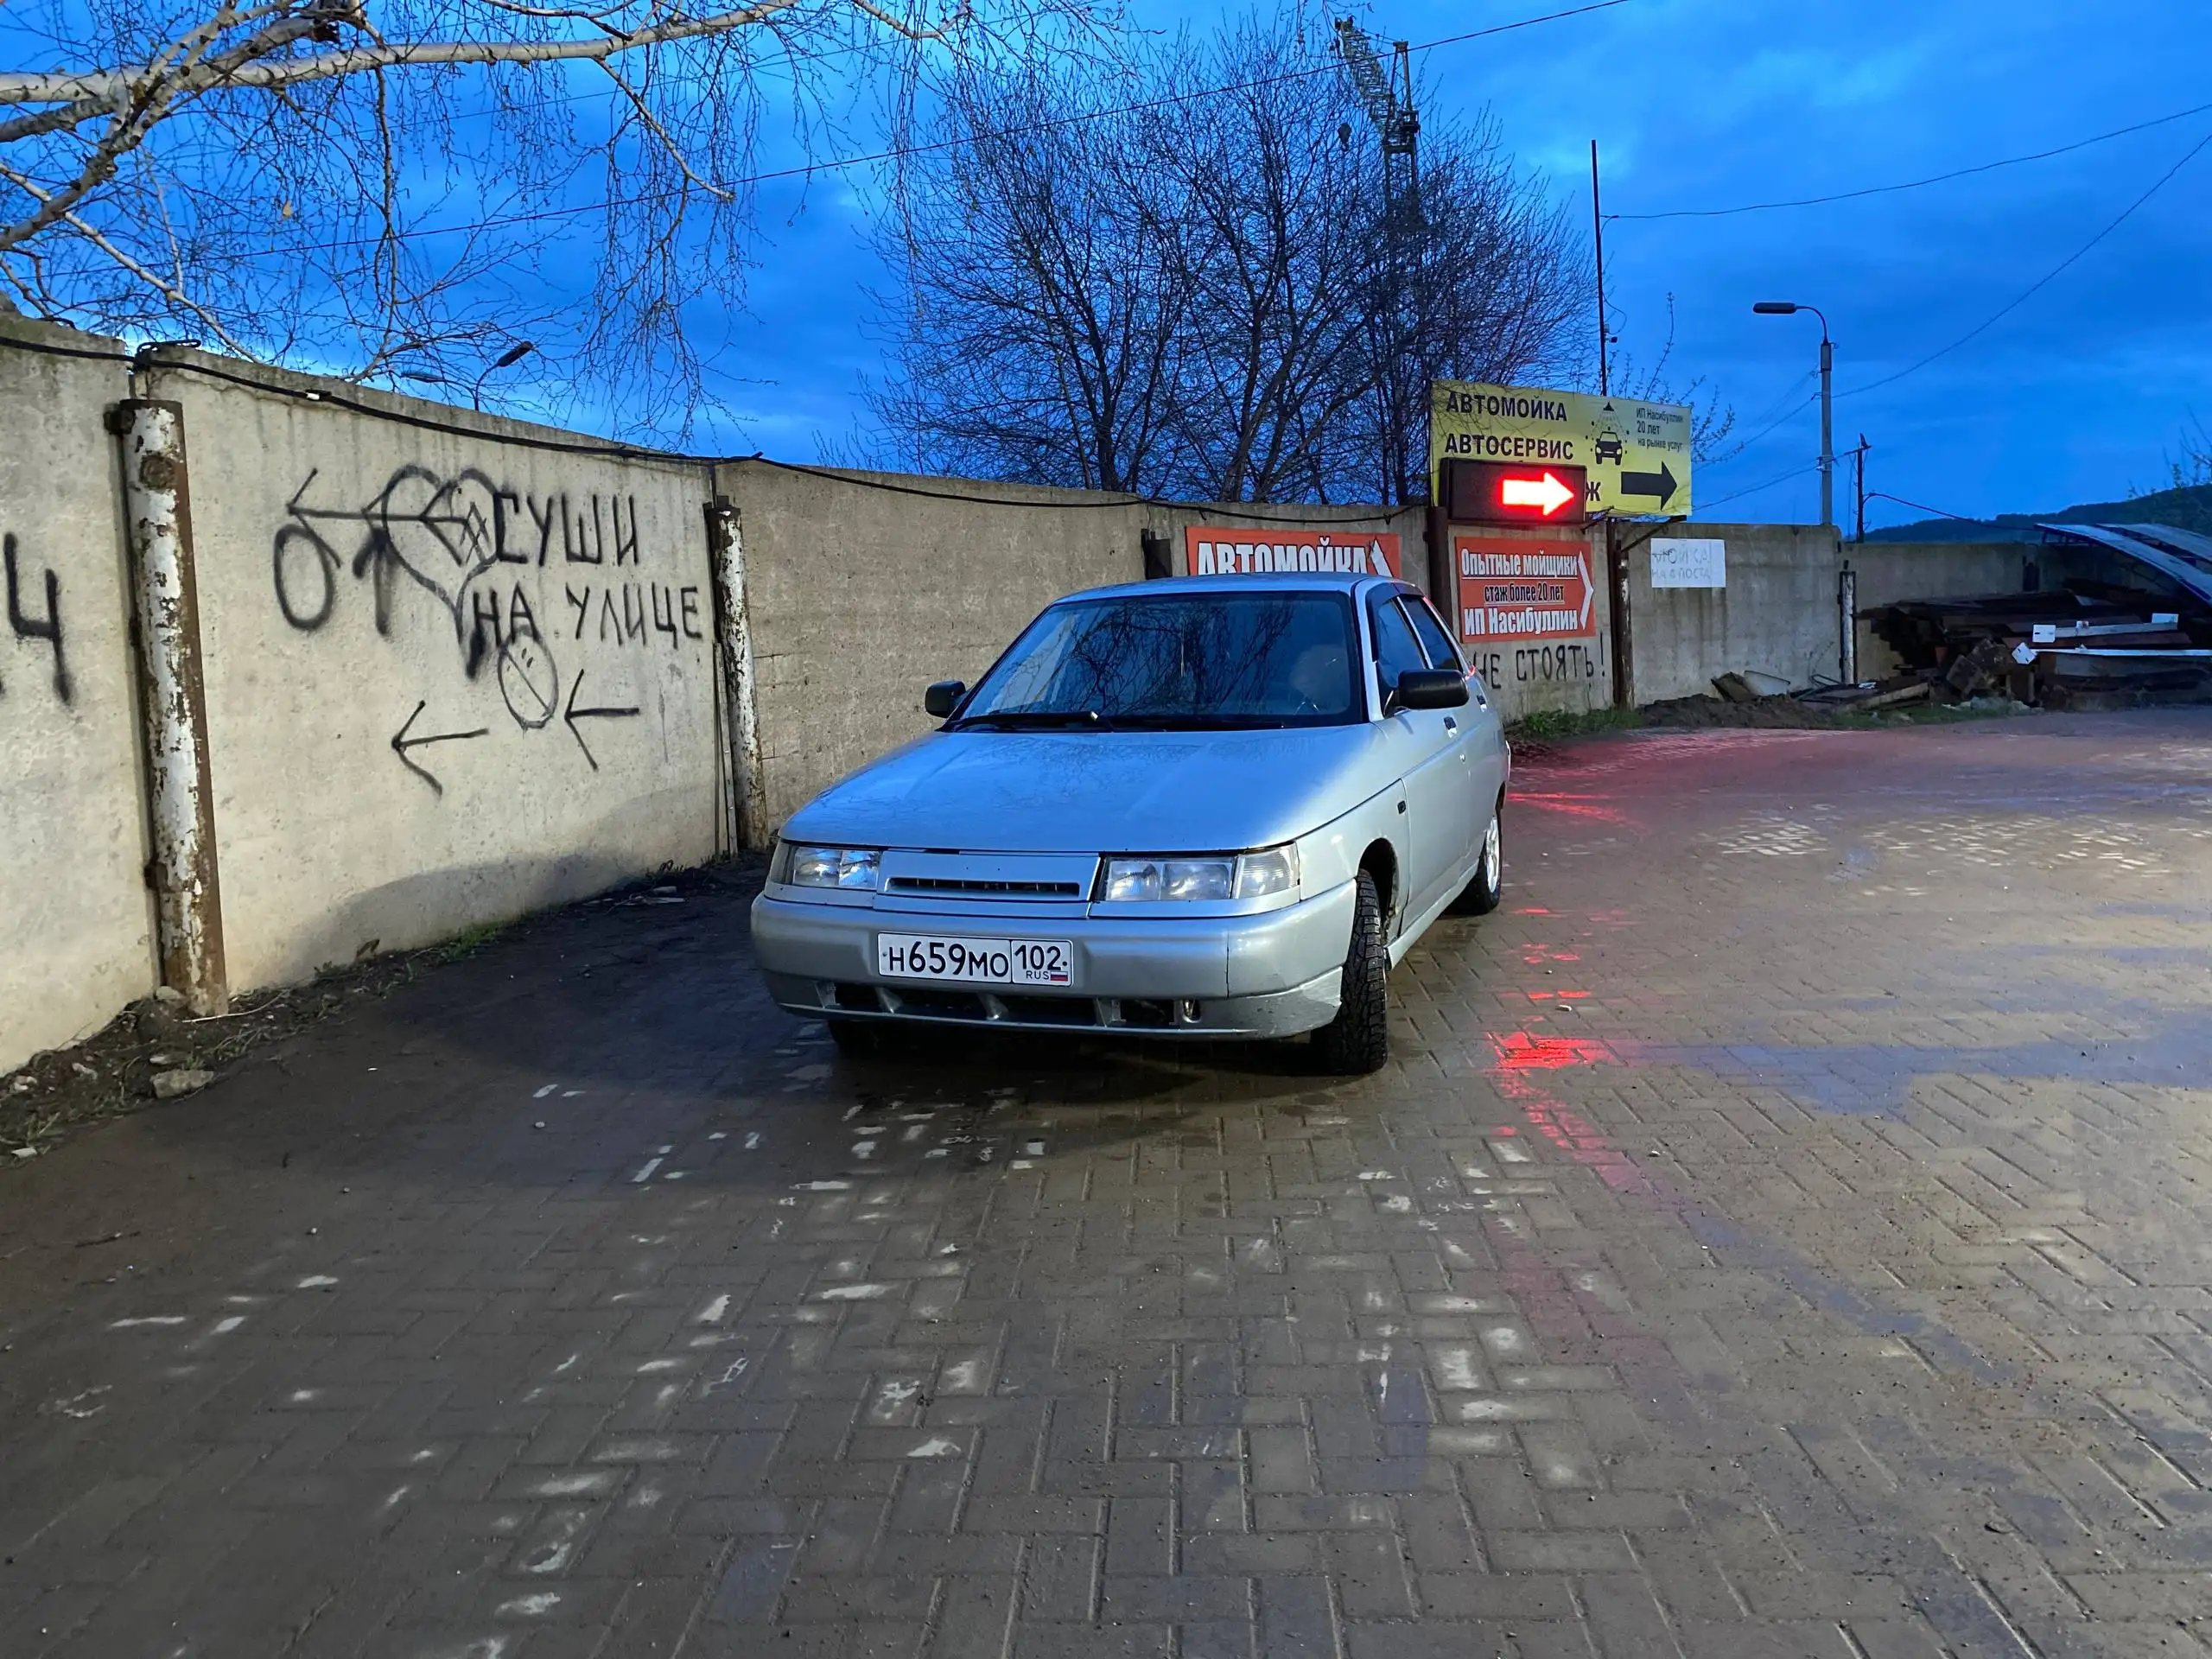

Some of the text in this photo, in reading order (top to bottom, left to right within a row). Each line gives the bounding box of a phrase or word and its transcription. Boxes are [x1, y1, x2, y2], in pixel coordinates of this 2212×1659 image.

[1446, 392, 1567, 422] АВТОМОЙКА
[1636, 408, 1646, 418] ИП
[1637, 420, 1661, 435] 20 лет
[1637, 438, 1646, 447] на
[1444, 433, 1574, 461] АВТОСЕРВИС
[493, 492, 639, 567] СУШИ
[1198, 536, 1369, 574] АВТОМОЙКА
[1461, 548, 1578, 578] Опытные мойщики
[1484, 582, 1565, 602] стаж более 20 лет
[473, 580, 702, 651] НА УЛИЦЕ
[1464, 606, 1578, 636] ИП Насибуллин
[888, 941, 1062, 978] Н659МО 102
[1026, 970, 1050, 981] RUS
